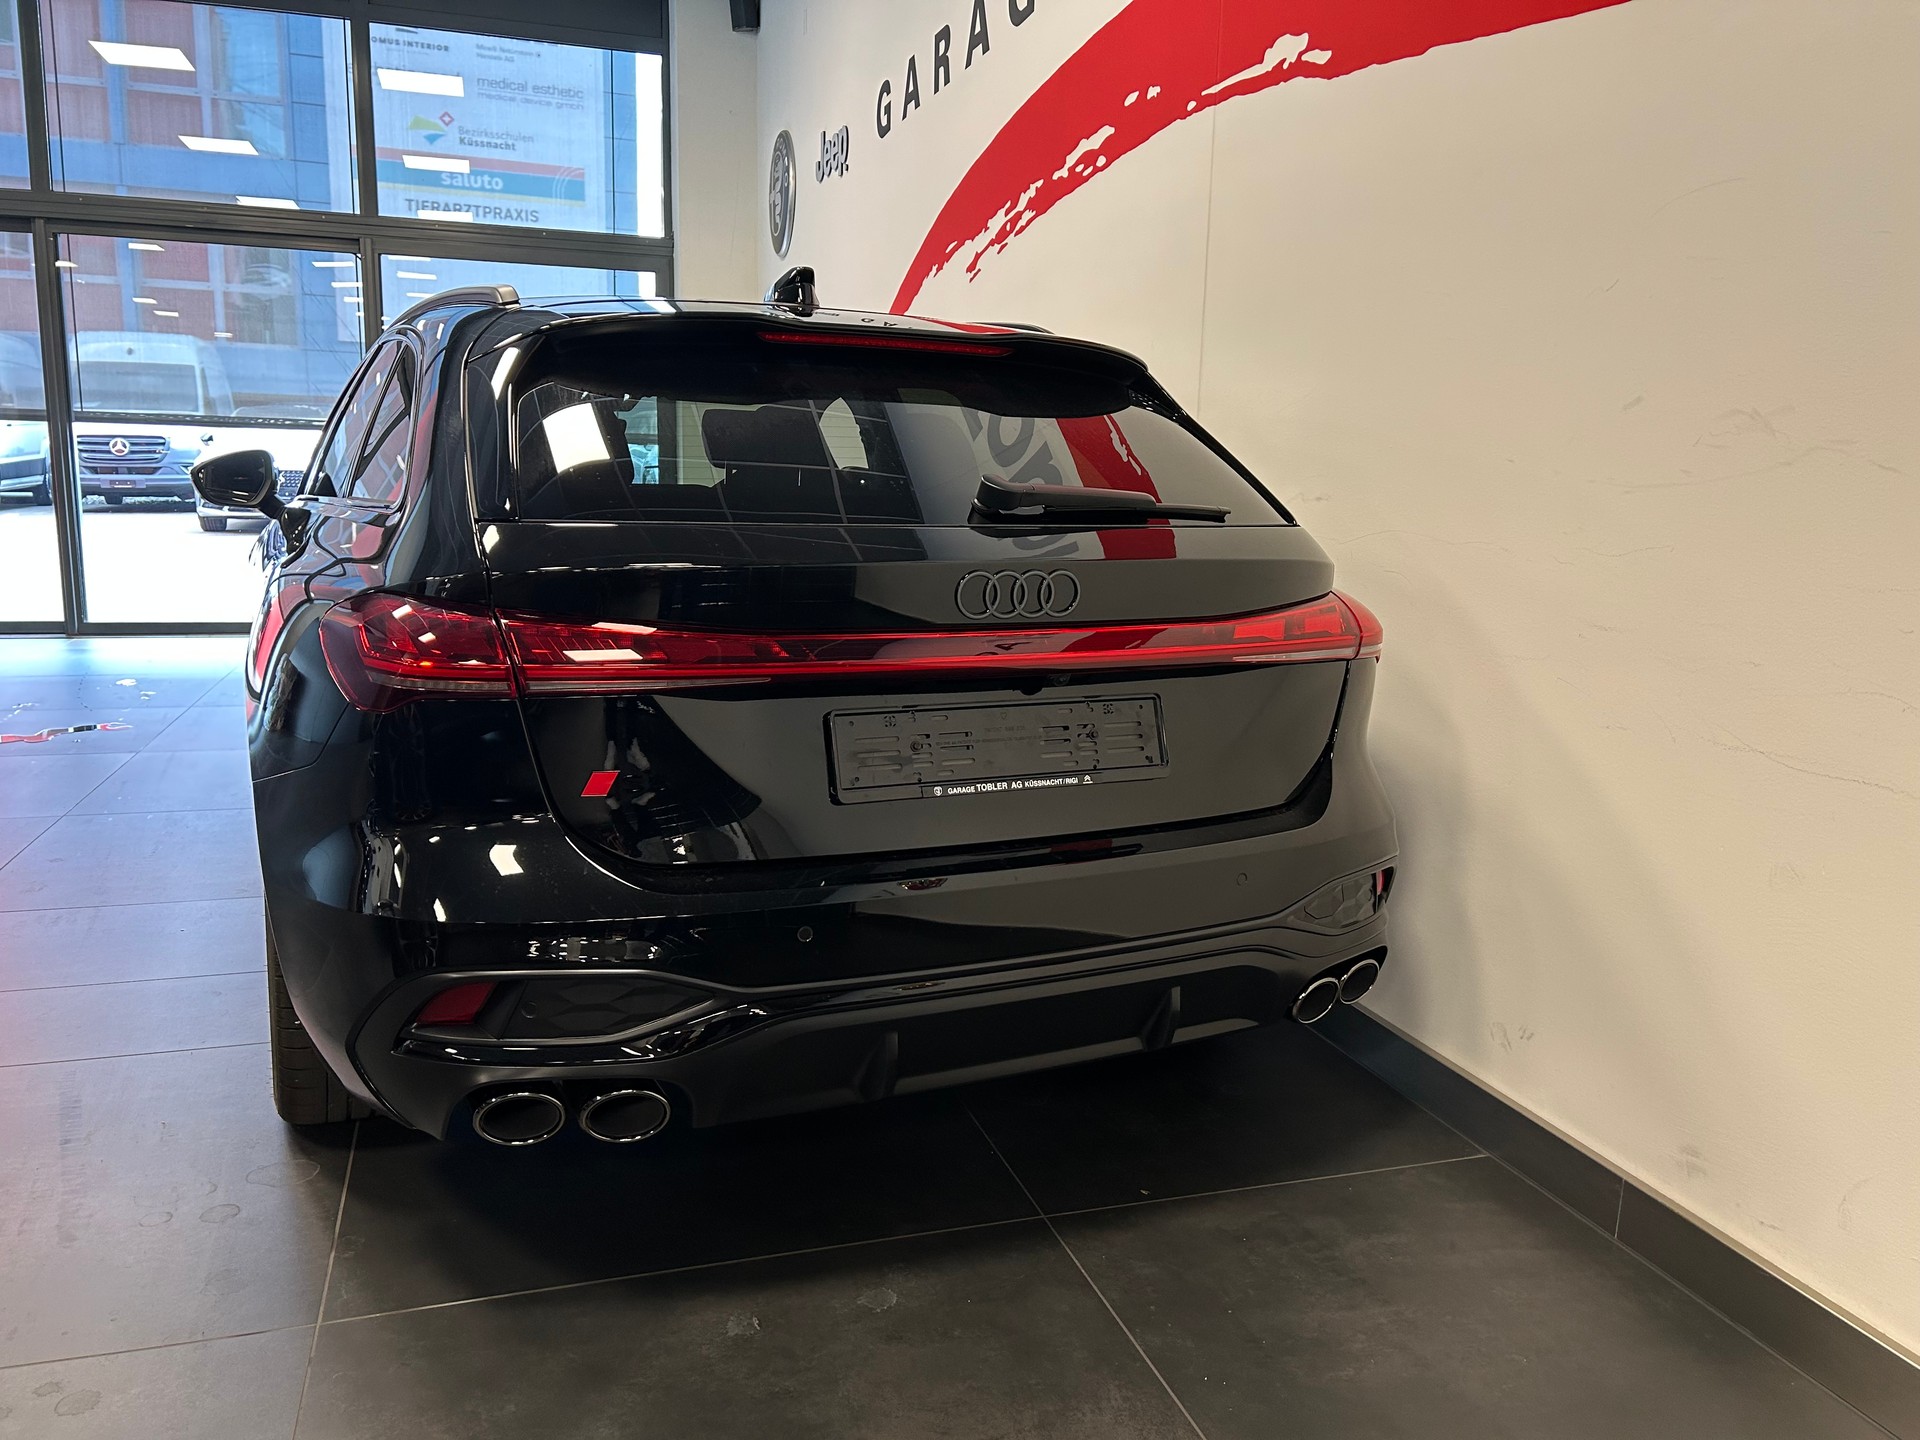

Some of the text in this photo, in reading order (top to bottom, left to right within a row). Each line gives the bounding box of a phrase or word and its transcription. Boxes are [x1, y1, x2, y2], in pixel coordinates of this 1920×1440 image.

[370, 36, 450, 52] OMUS INTERIOR
[477, 77, 585, 99] medical esthetic
[458, 125, 535, 143] Bezirksschulen
[459, 136, 517, 151] Küssnacht
[815, 125, 849, 184] Jeep
[441, 171, 504, 190] saluto
[405, 198, 540, 223] TIERARZTPRAXIS
[947, 776, 1079, 795] GARAGE TOBLER AG KÜSSNACHT/RIGI
